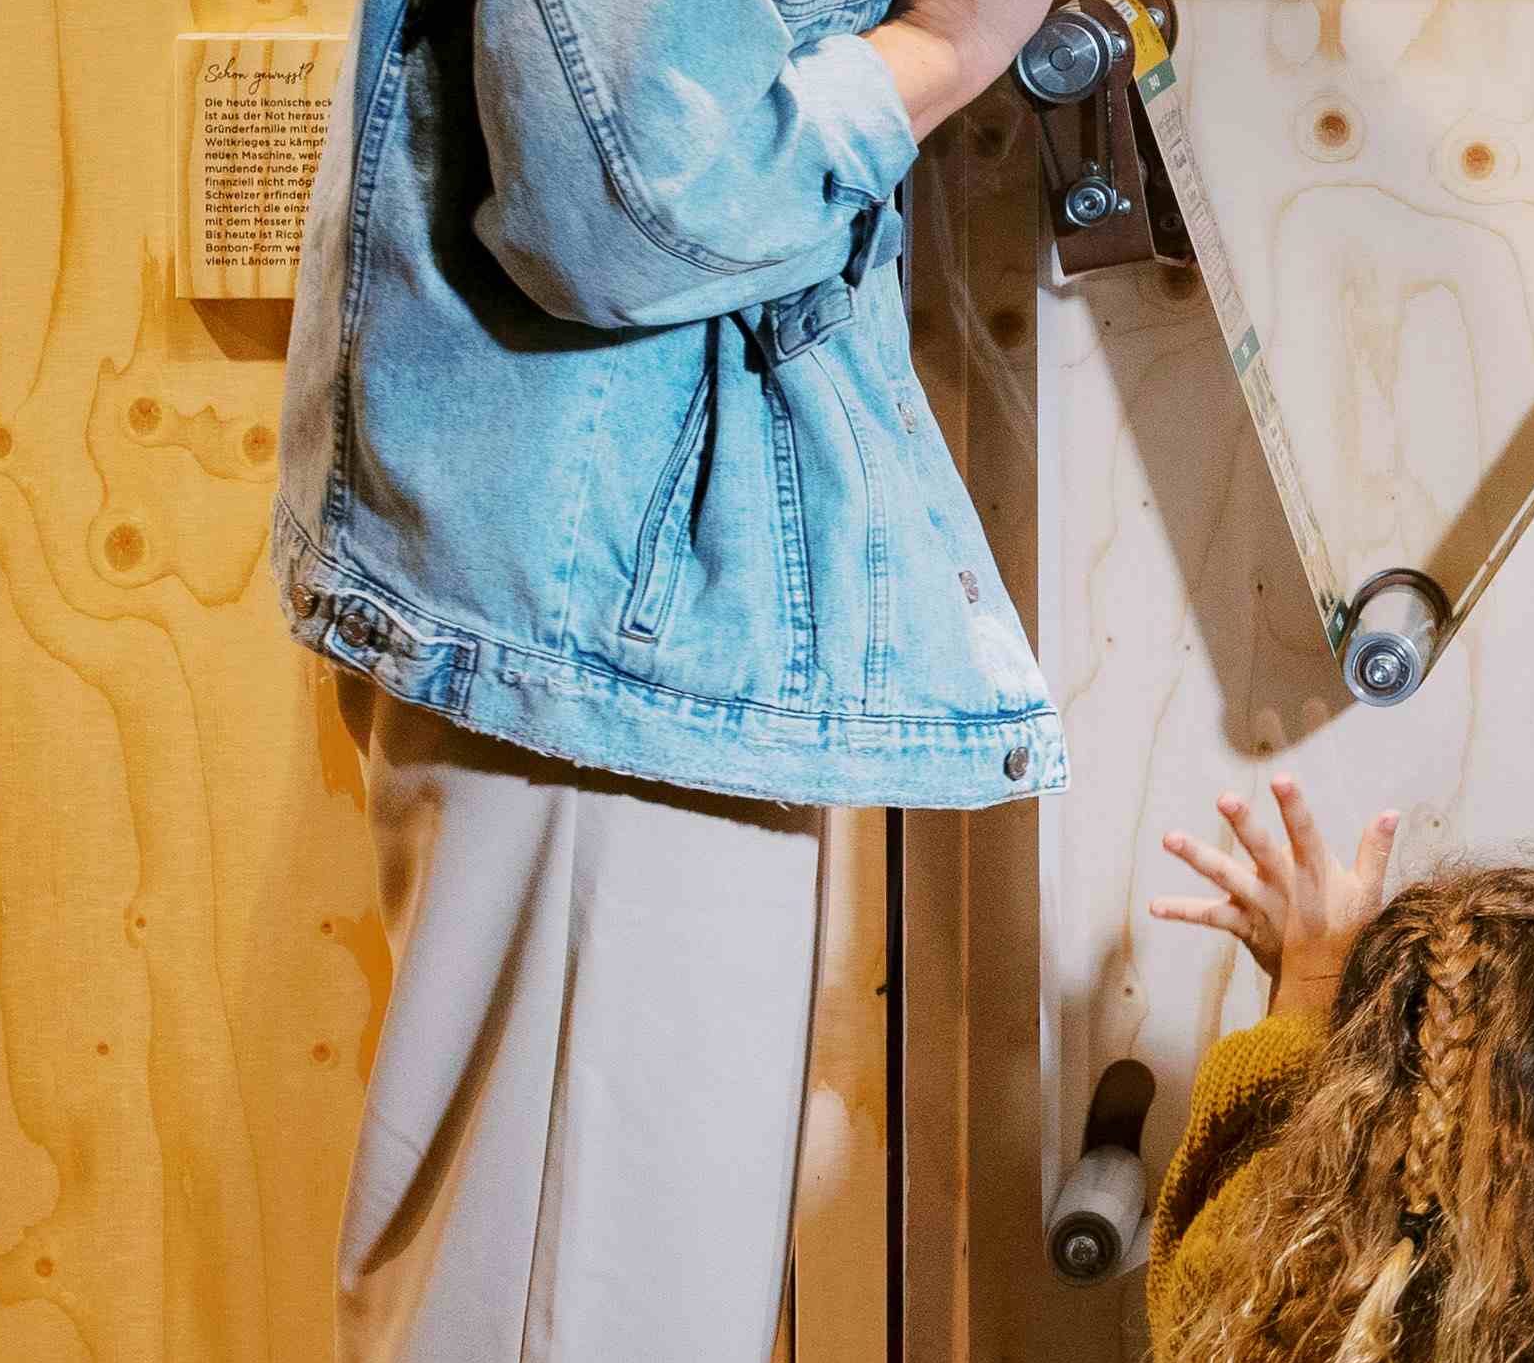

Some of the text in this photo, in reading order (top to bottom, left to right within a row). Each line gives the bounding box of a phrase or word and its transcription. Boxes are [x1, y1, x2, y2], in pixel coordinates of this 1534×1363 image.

[205, 56, 246, 83] Schon
[205, 98, 223, 107] Die
[226, 98, 257, 107] heute
[260, 98, 311, 107] ikonische
[205, 111, 324, 120] ist aus der Not heraus
[205, 124, 286, 134] Gründerfamilie
[290, 124, 308, 134] mit
[205, 137, 326, 148] Weltkrieges zu kämpf
[205, 152, 238, 160] neuen
[242, 151, 295, 160] Maschine,
[205, 164, 263, 173] mundende
[267, 164, 298, 173] runde
[205, 178, 254, 186] finanziell
[257, 178, 287, 186] nicht
[205, 191, 313, 199] Schweizer erfinderi
[205, 204, 259, 213] Richterich
[264, 204, 281, 213] die
[205, 217, 223, 226] mit
[226, 217, 250, 226] dem
[254, 217, 292, 226] Messer
[206, 230, 303, 239] Bis heute ist Ricol
[206, 243, 282, 252] Bonbon-Form
[206, 257, 238, 266] vielen
[241, 257, 285, 266] Ländern
